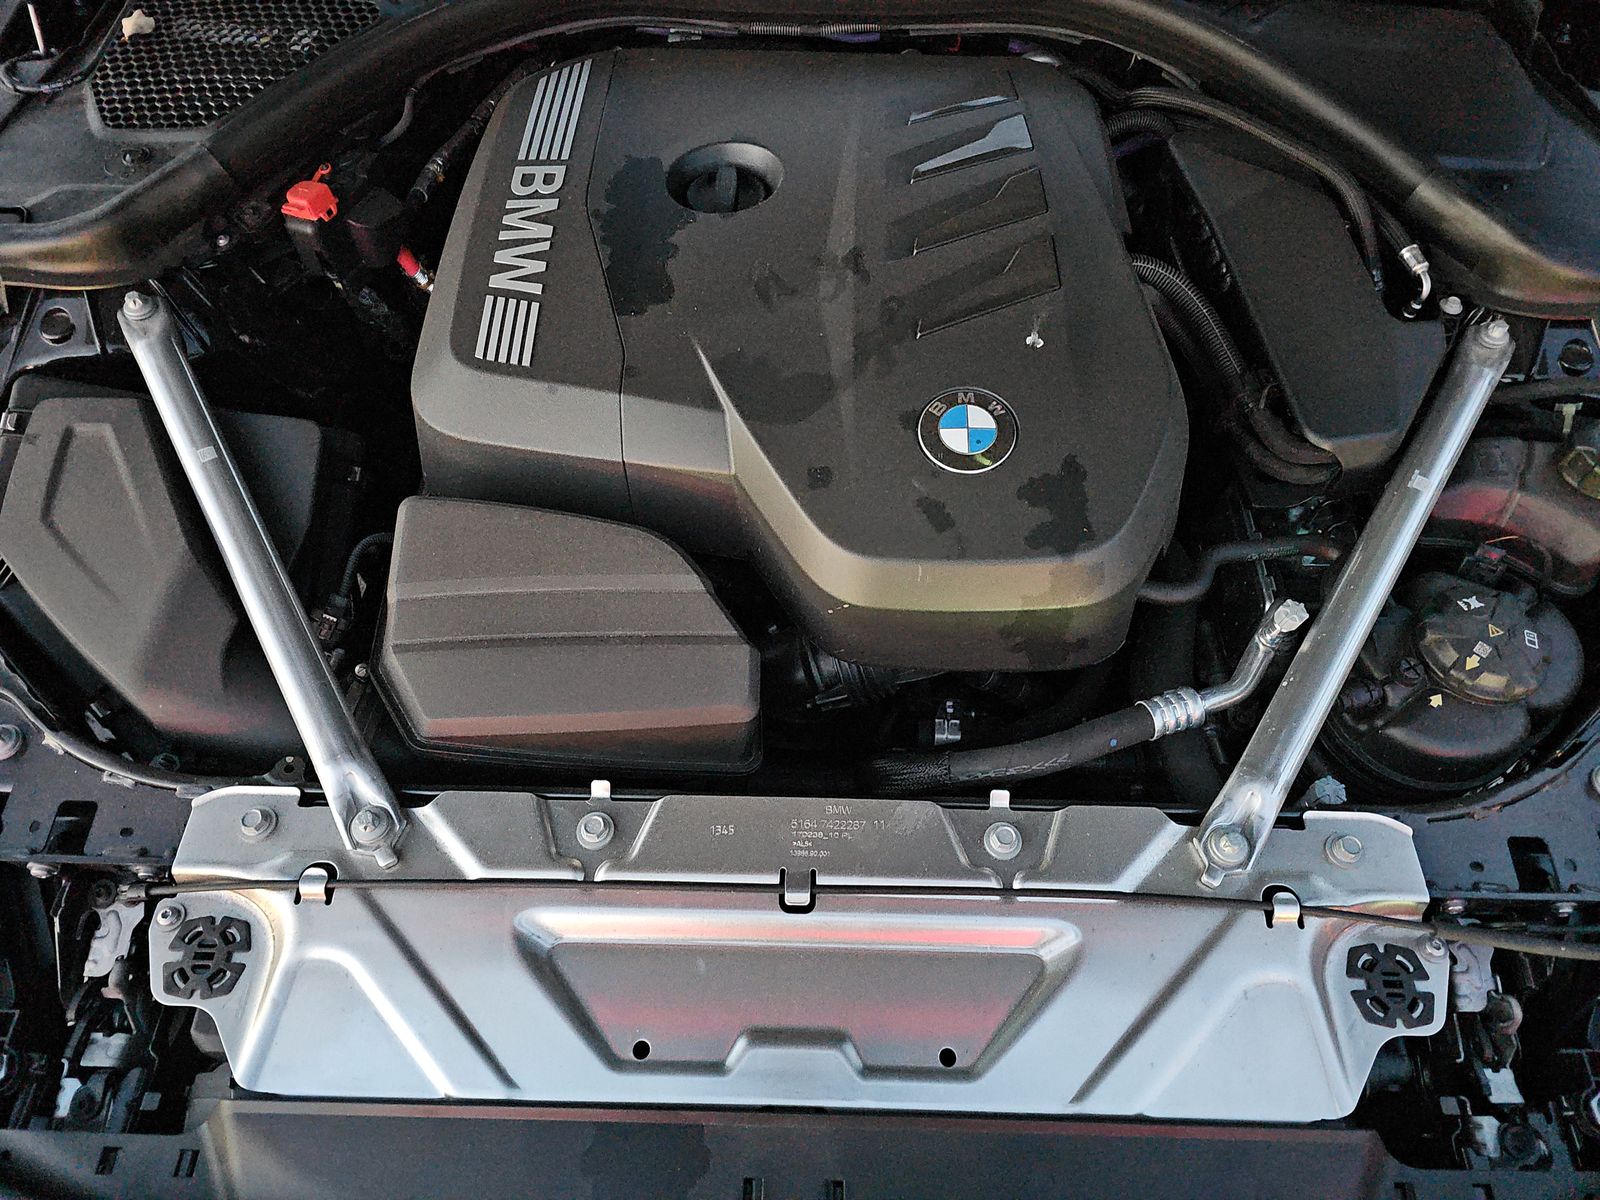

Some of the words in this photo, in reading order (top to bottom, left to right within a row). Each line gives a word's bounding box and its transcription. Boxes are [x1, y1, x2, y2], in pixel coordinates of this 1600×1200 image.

[488, 165, 567, 295] BMW
[928, 392, 1006, 417] BMW
[825, 805, 852, 815] BMW
[710, 824, 735, 836] 1345
[791, 819, 817, 829] 5164
[820, 820, 866, 830] 7422287
